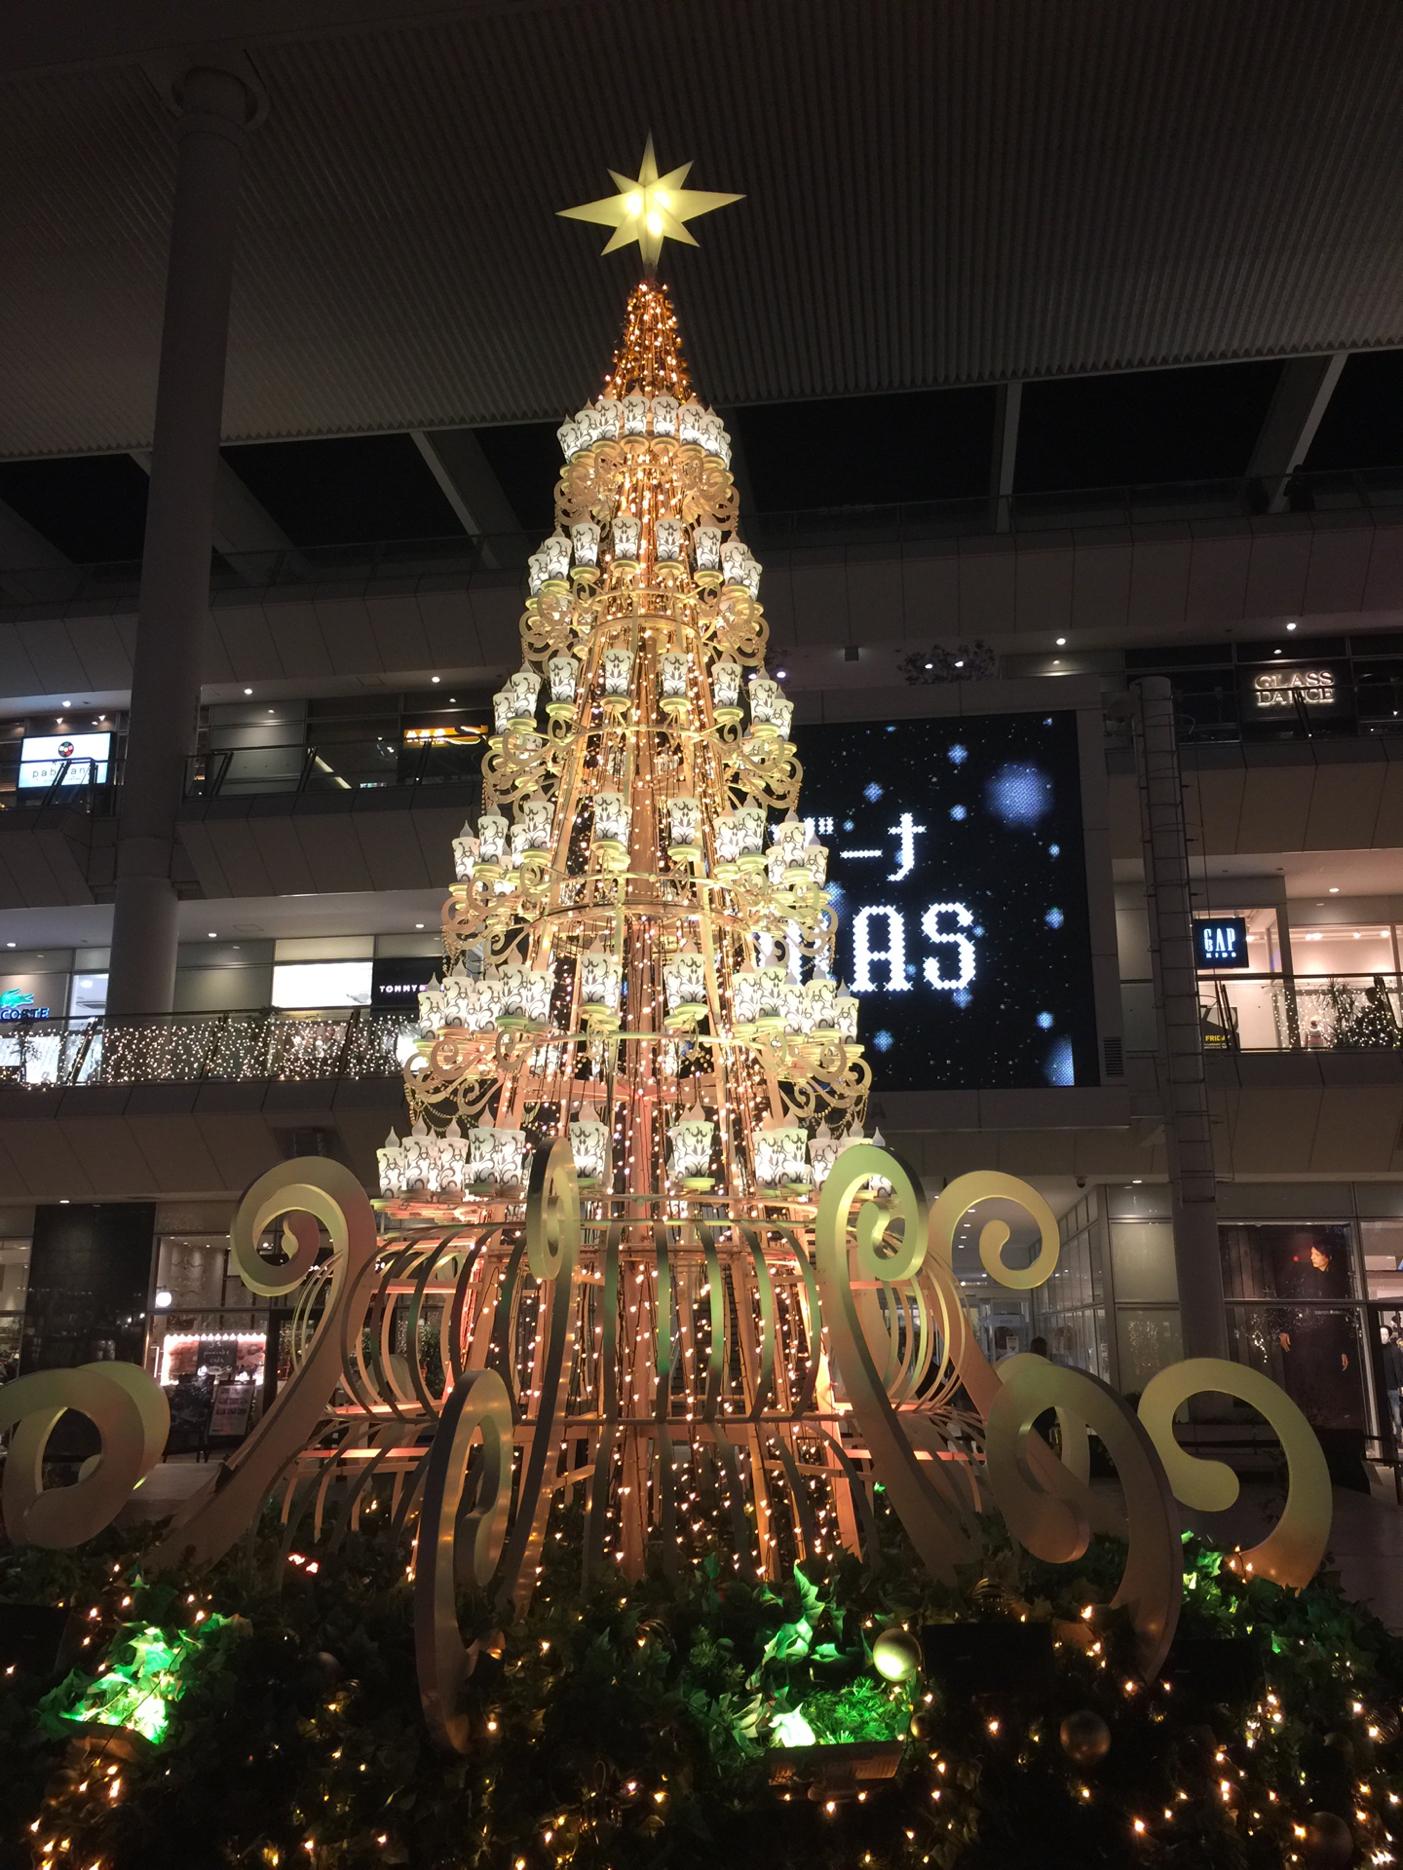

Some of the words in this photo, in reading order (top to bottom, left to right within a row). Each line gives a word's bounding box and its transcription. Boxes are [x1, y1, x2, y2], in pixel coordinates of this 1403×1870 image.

[1255, 671, 1335, 689] GLASS
[1203, 927, 1236, 952] GAP
[379, 984, 418, 993] TOMMY
